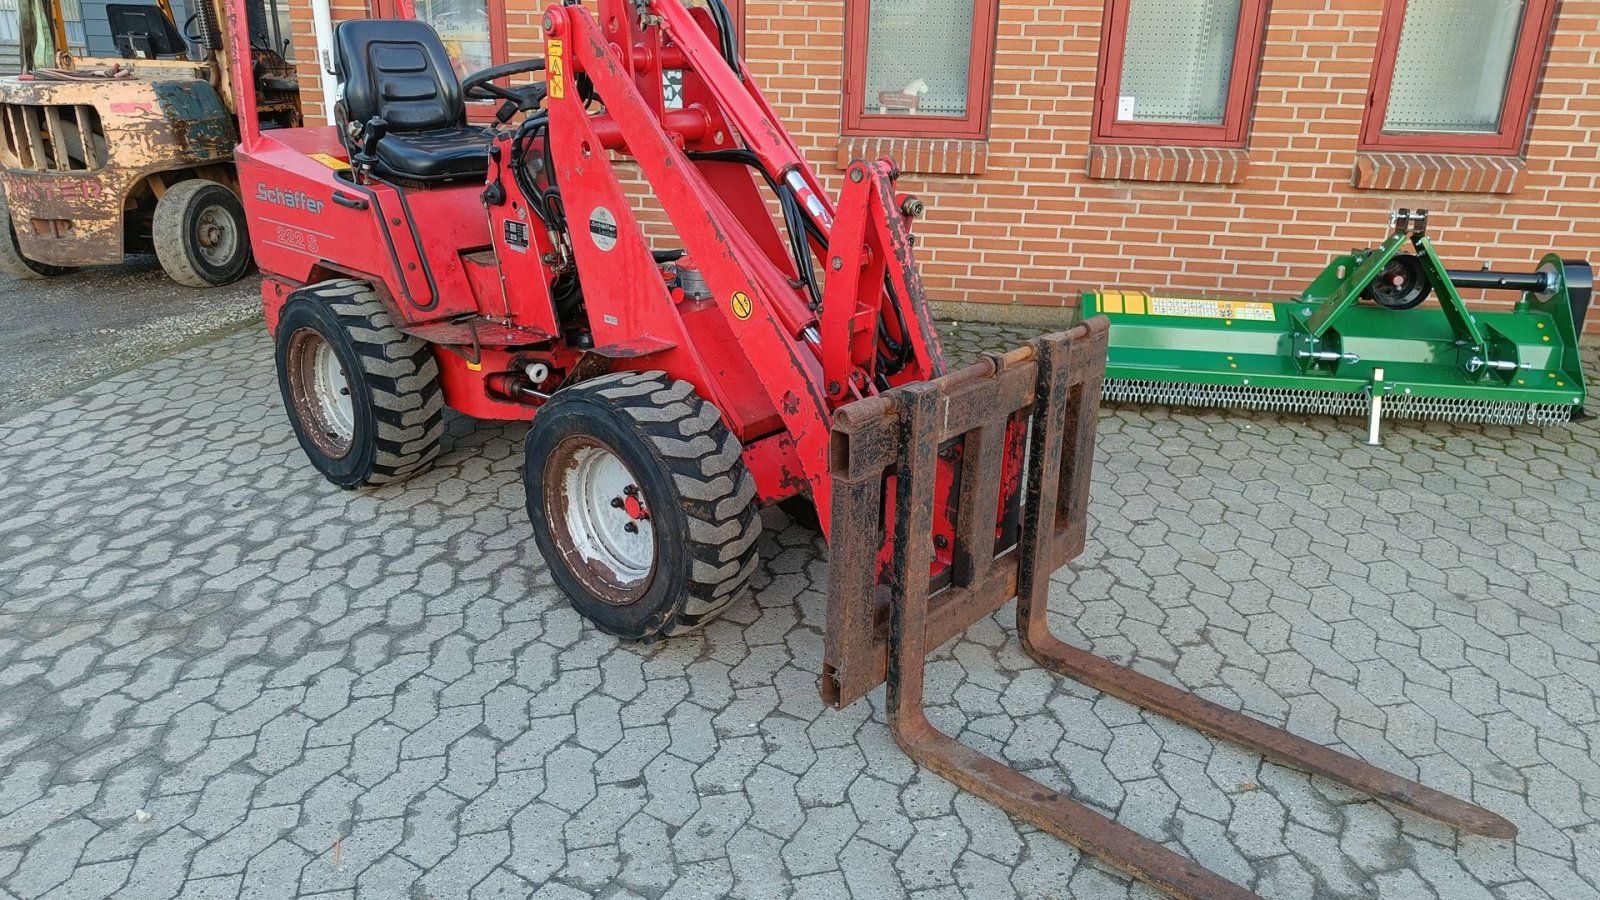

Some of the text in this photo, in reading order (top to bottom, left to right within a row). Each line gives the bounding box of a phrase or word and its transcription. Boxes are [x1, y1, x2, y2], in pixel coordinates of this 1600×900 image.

[9, 176, 102, 202] STER
[255, 181, 325, 215] Schäffer
[276, 226, 319, 253] 222 S
